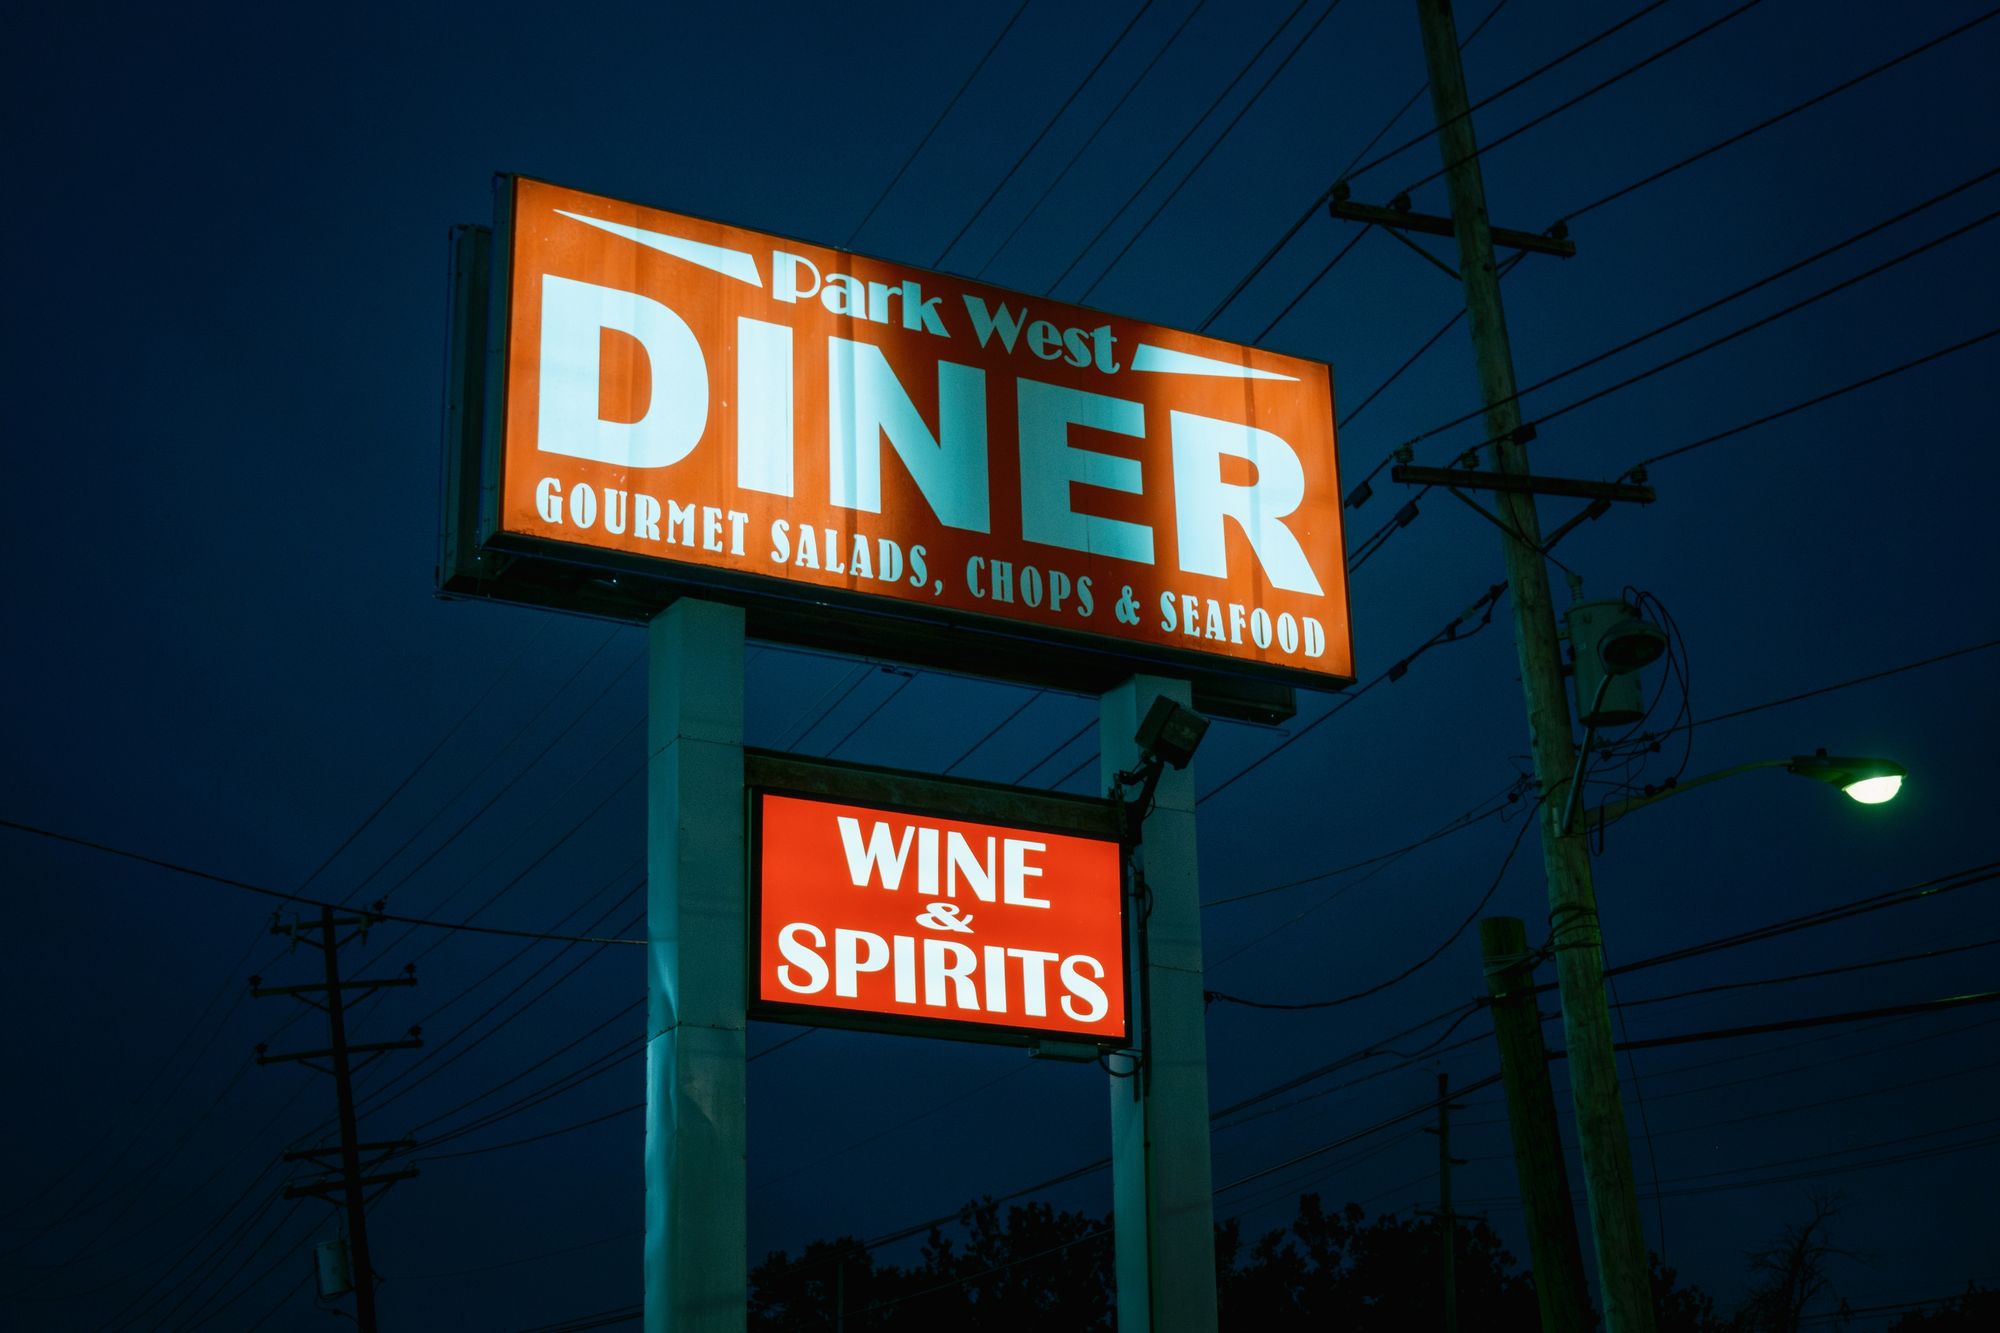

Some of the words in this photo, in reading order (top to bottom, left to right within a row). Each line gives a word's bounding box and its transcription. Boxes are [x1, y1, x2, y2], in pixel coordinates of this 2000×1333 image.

[772, 250, 951, 338] Park
[962, 294, 1121, 375] West
[537, 273, 1325, 598] DINER
[534, 476, 749, 557] GOURMET
[769, 517, 943, 597] SALADS,
[966, 556, 1094, 617] CHOPS
[1115, 584, 1141, 626] &
[1160, 590, 1326, 658] SEAFOOD
[836, 815, 1051, 910] WINE
[915, 901, 974, 934] &
[776, 921, 1109, 1024] SPIRITS
